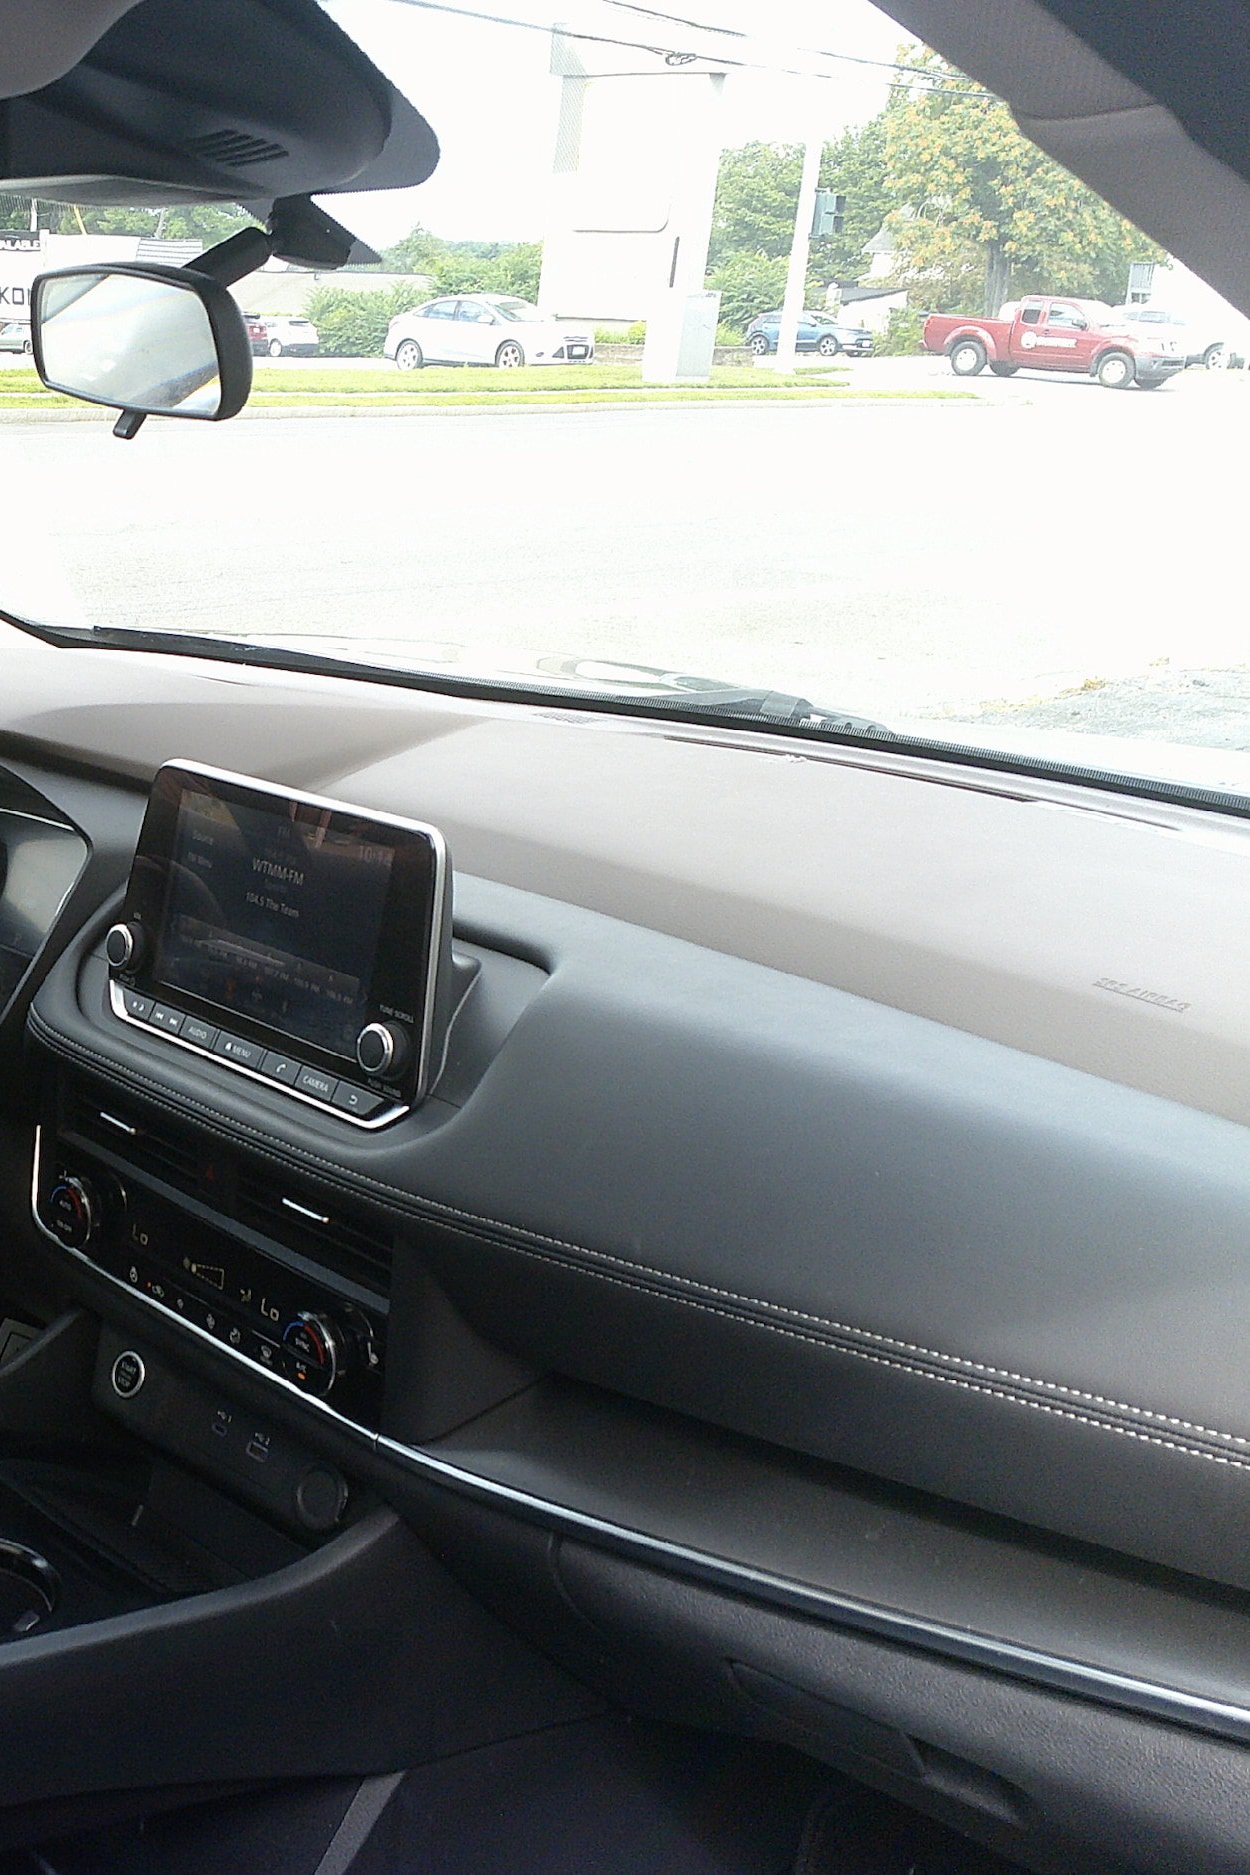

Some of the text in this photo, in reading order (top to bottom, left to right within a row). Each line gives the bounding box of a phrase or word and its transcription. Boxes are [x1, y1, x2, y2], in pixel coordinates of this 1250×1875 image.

[252, 858, 304, 886] WTMM-FM
[188, 1026, 208, 1040] AUDIO
[232, 1044, 252, 1059] MENU
[302, 1074, 330, 1092] CAMERA
[132, 1223, 148, 1245] Lo
[260, 1298, 280, 1322] Lo
